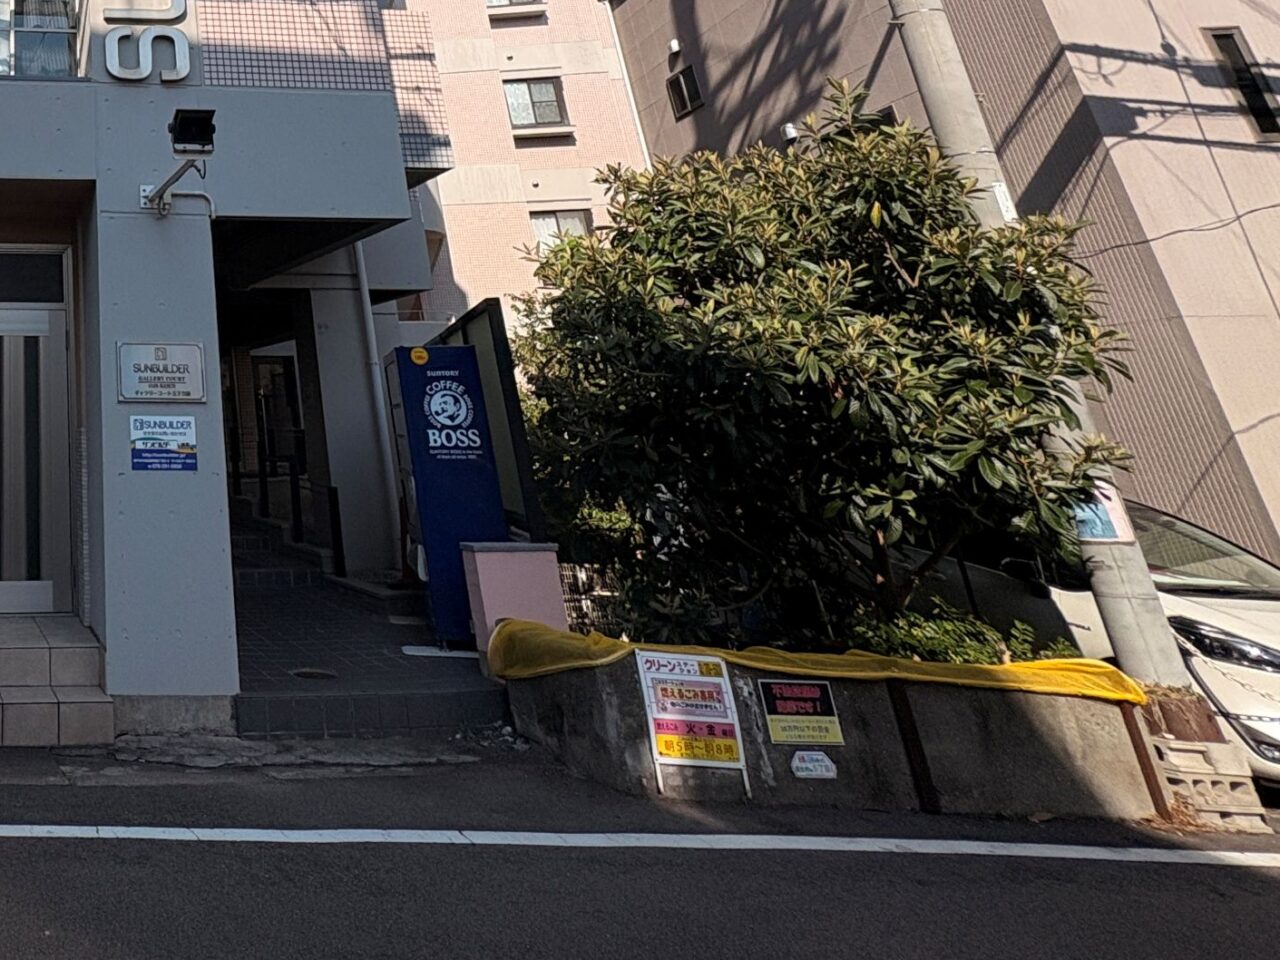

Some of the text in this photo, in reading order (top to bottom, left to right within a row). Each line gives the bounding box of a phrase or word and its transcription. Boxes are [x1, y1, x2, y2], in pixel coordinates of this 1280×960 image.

[133, 363, 190, 374] SUNBUILDER
[426, 380, 466, 395] COFFEE
[143, 420, 192, 430] SUNBUILDER
[426, 429, 481, 447] BOSS
[644, 658, 676, 672] クリーン
[685, 723, 717, 736] 火・金
